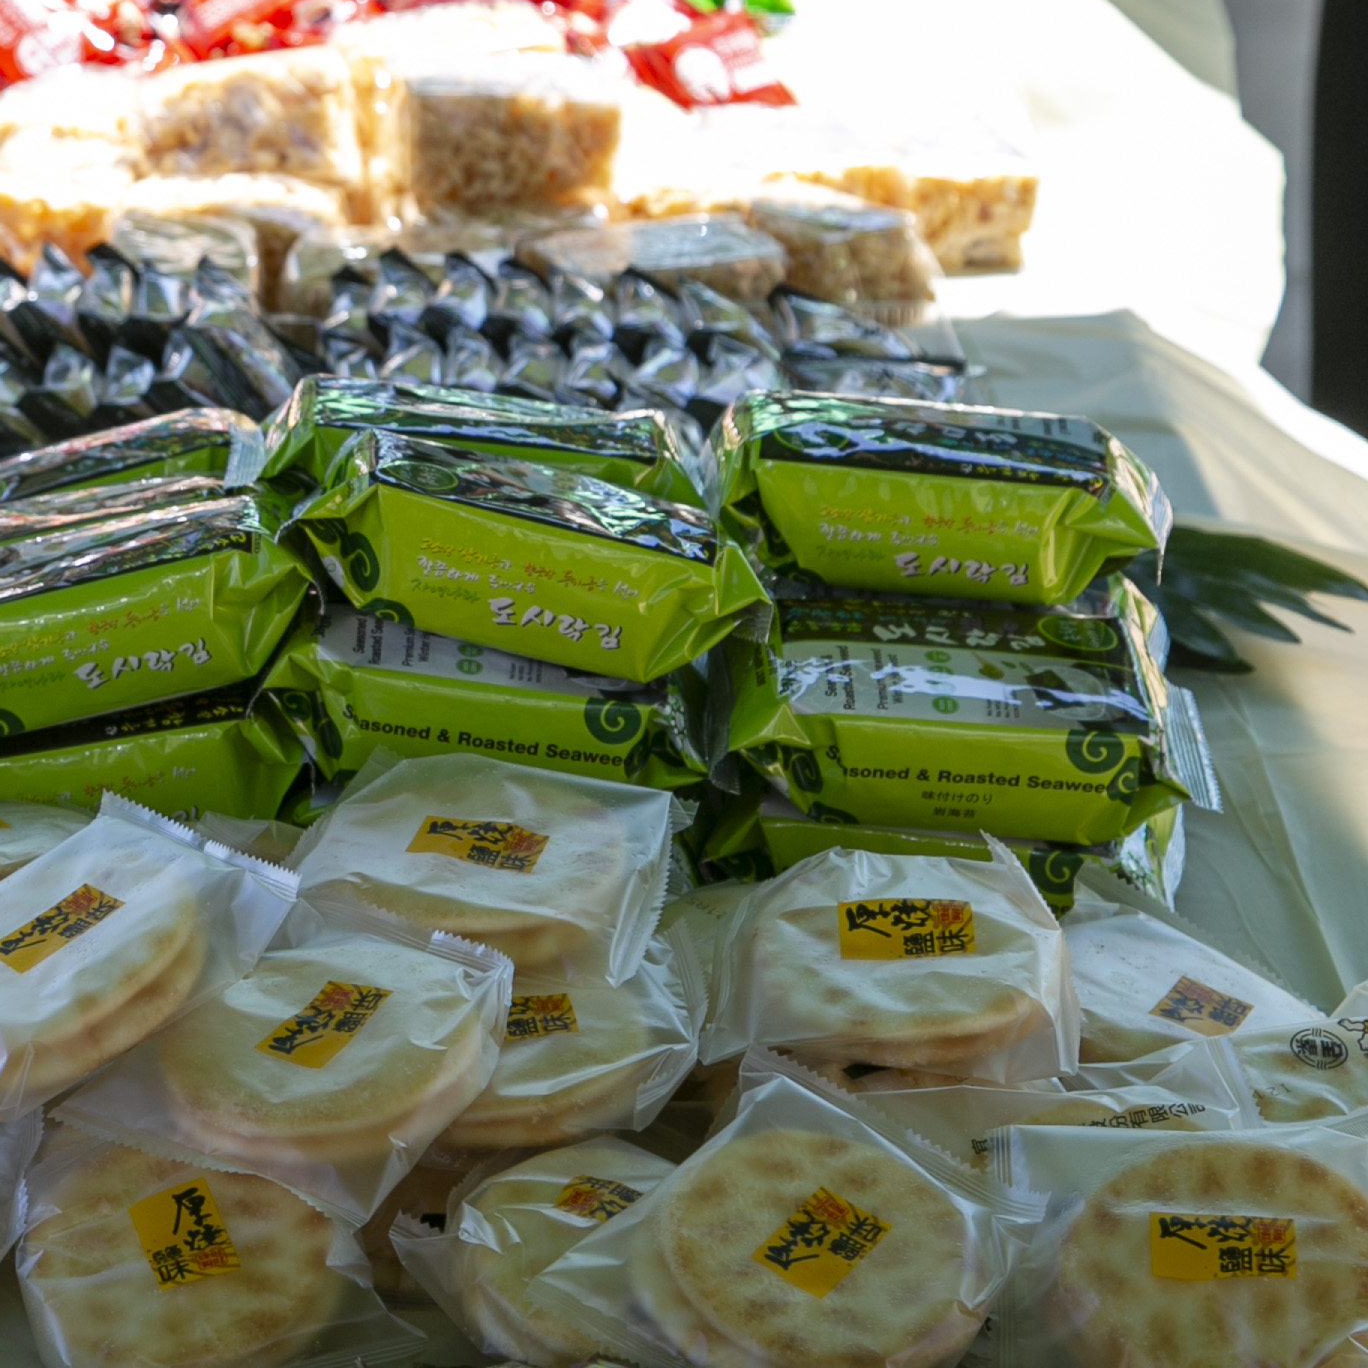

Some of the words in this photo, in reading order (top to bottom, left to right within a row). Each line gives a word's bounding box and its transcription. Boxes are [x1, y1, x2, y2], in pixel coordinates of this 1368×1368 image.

[438, 729, 452, 744] &
[457, 731, 539, 757] Roasted
[916, 769, 931, 783] &
[937, 770, 1021, 787] Roasted
